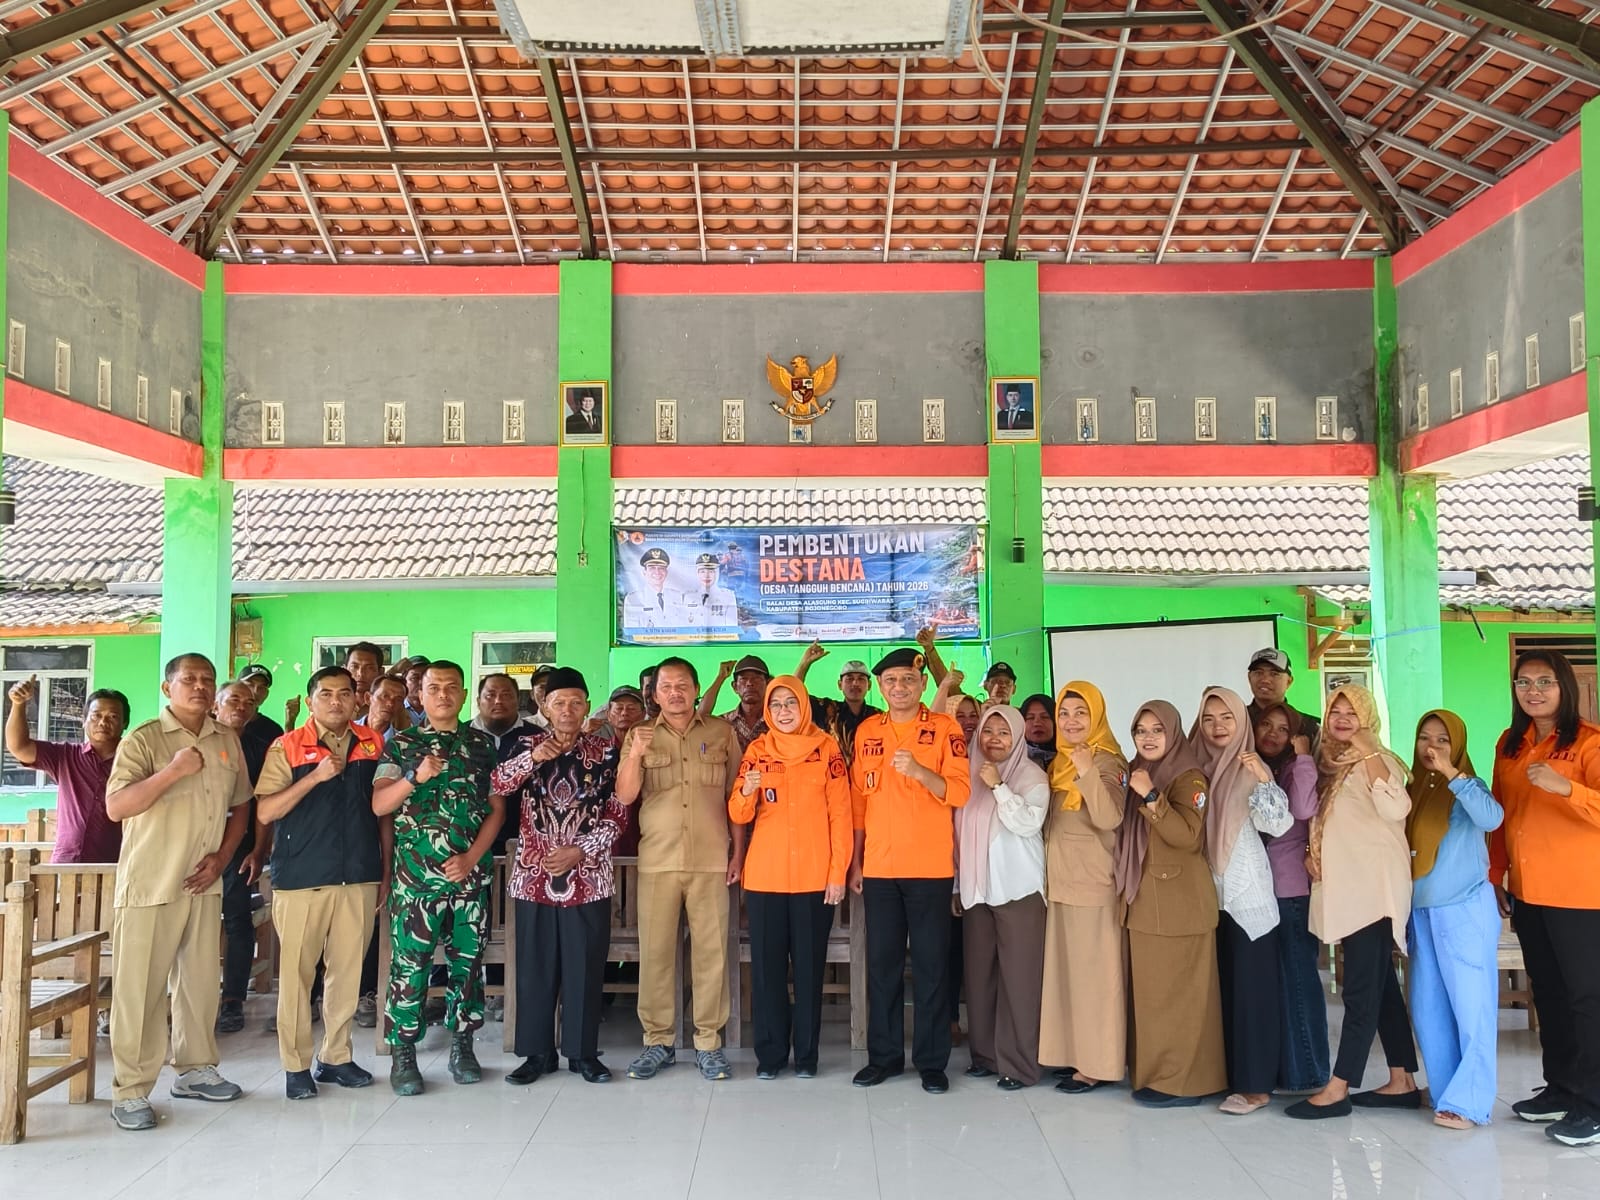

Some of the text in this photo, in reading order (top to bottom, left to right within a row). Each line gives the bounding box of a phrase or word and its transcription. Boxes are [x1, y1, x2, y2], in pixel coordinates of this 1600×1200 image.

[759, 531, 925, 556] PEMBENTUKAN
[760, 557, 866, 582] DESTANA
[760, 581, 928, 595] (DESA TANGGUH BENCANA) TAHUN 2026
